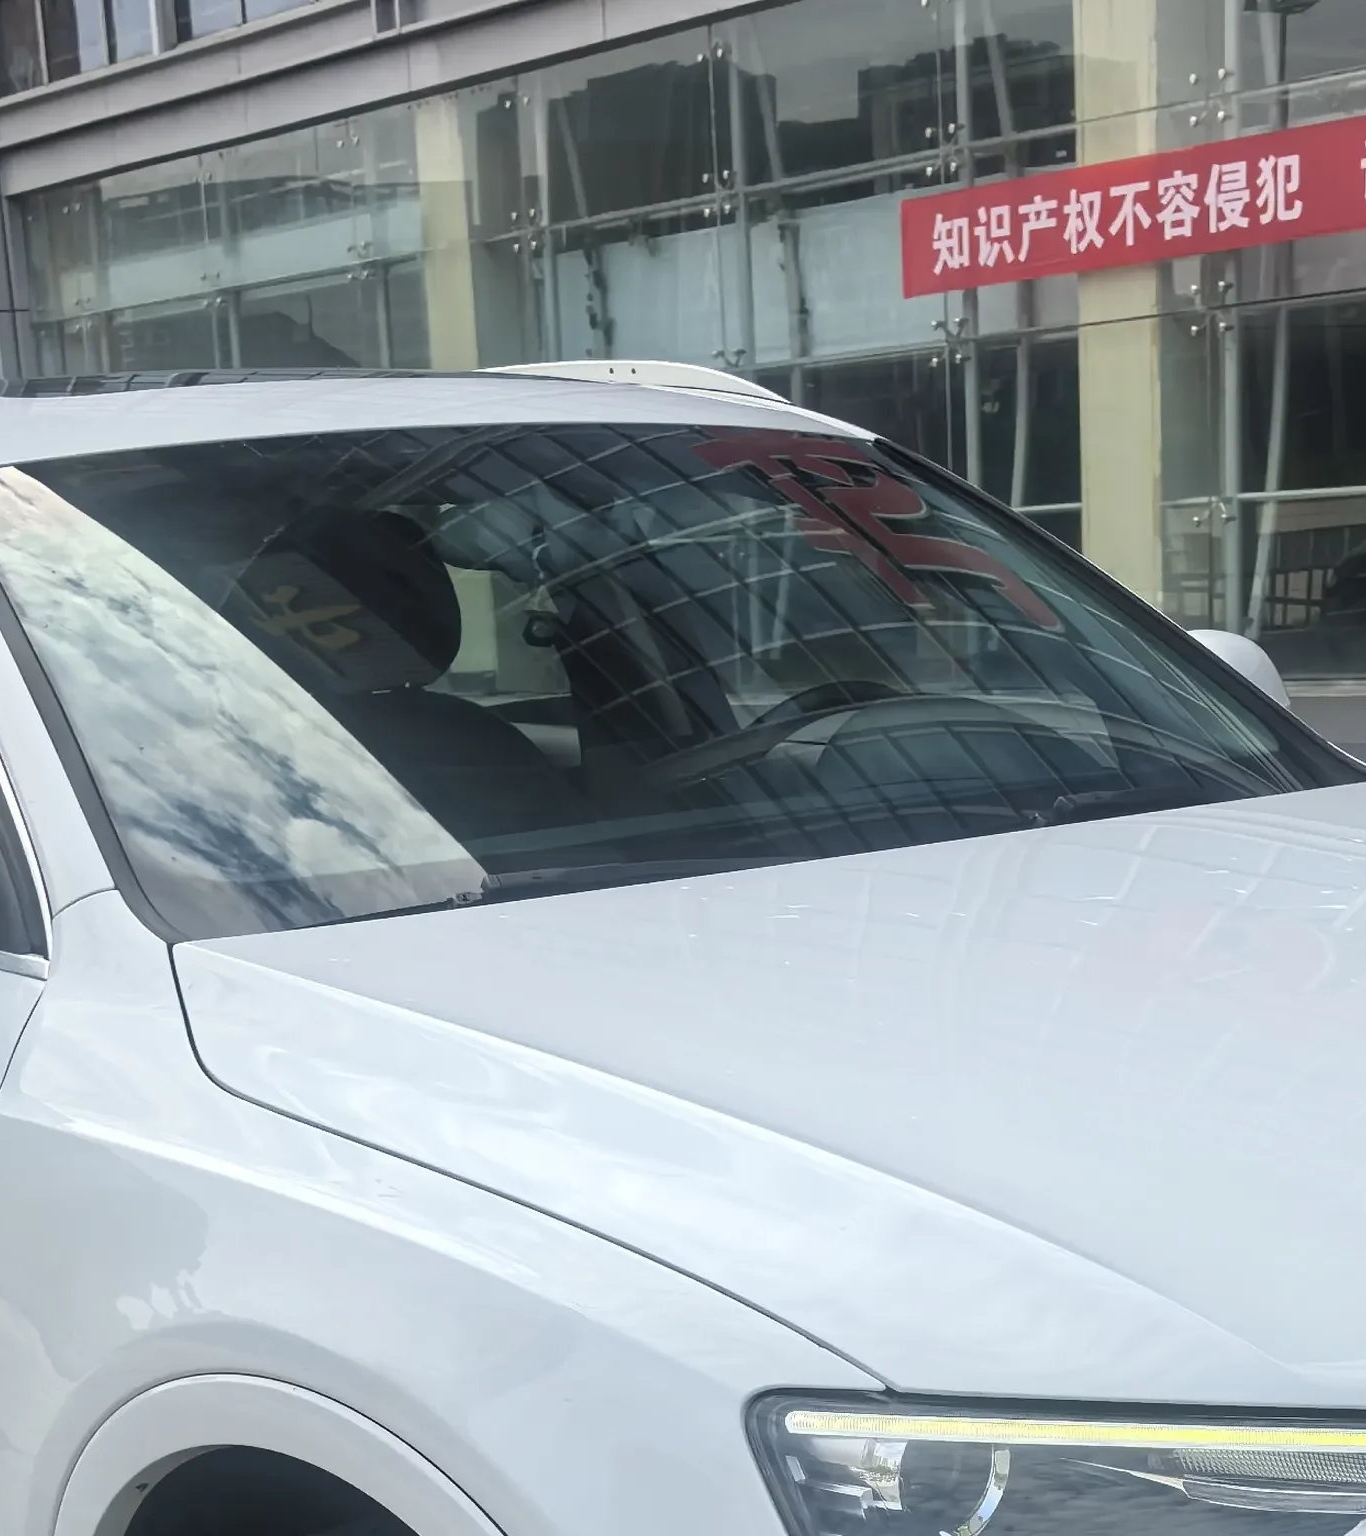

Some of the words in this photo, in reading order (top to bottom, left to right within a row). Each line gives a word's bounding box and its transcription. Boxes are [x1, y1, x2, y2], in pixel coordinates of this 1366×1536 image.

[932, 154, 1303, 275] 知识产权不容侵犯
